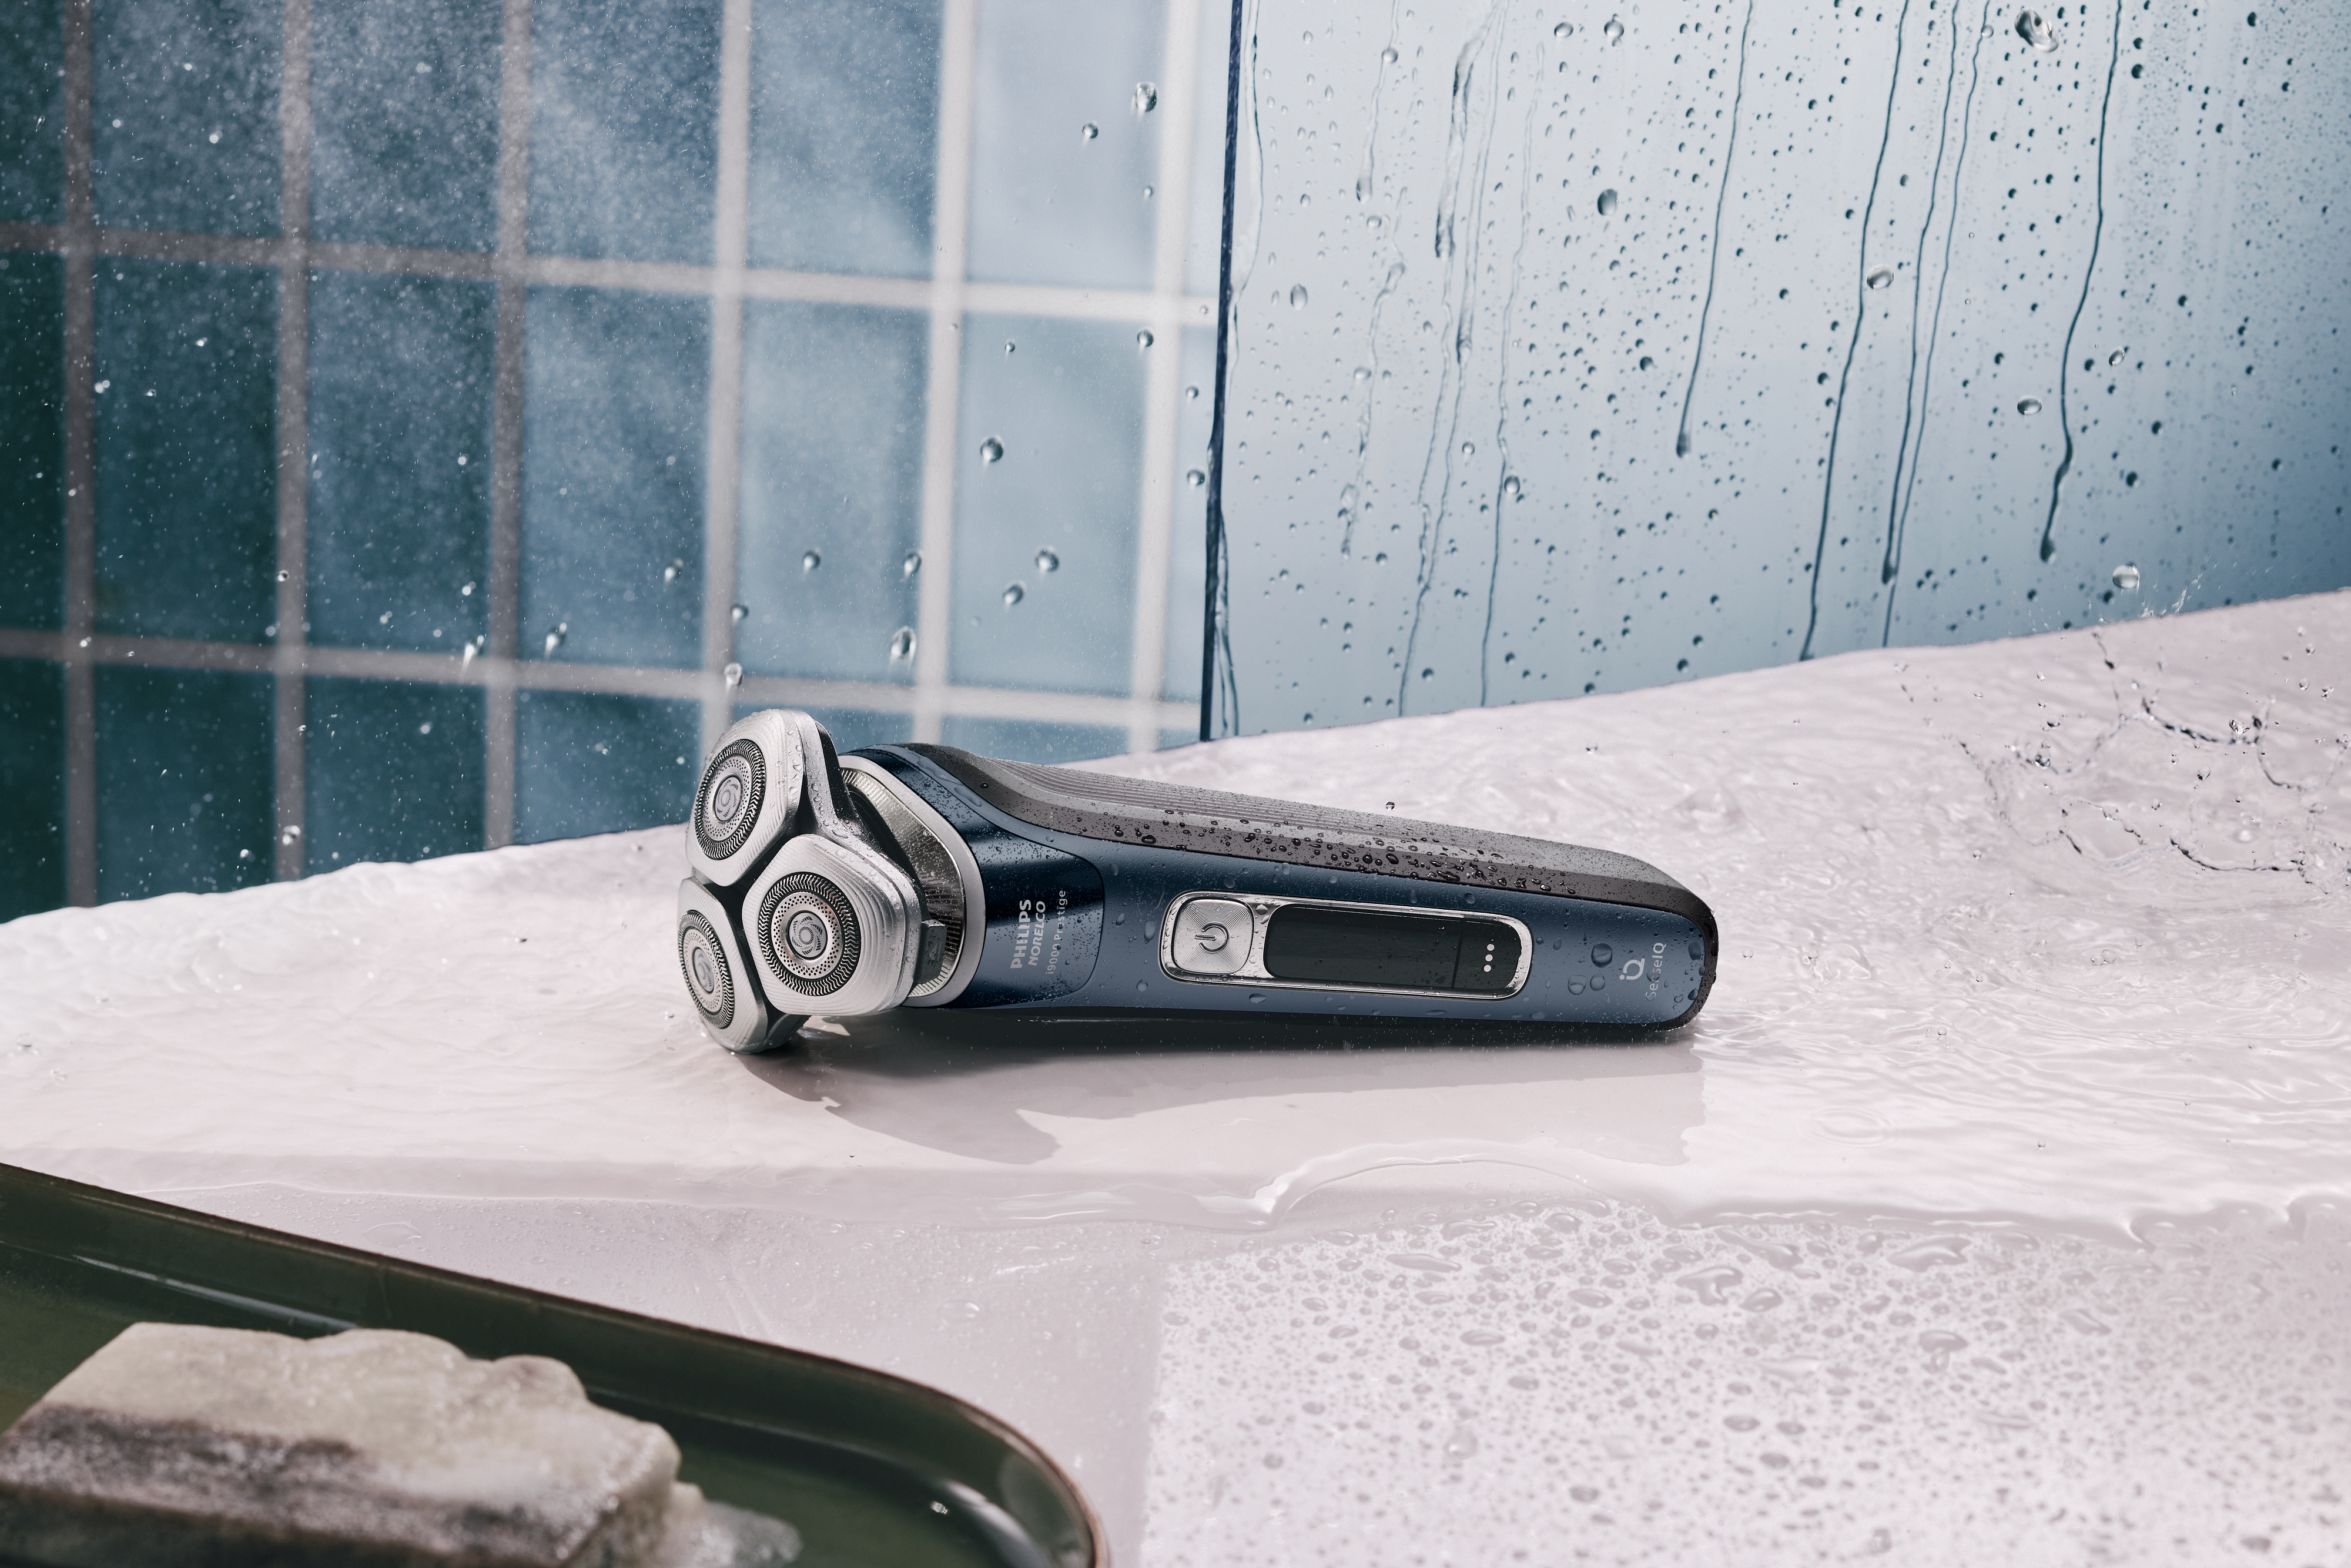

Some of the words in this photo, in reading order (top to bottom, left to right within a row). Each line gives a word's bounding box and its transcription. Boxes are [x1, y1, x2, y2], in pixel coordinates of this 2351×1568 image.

[1010, 899, 1032, 969] PHILIPS
[1028, 901, 1046, 966] NORELCO
[1046, 944, 1061, 974] i9000
[1054, 890, 1067, 940] Prestige
[1646, 943, 1666, 997] SenseIQ
